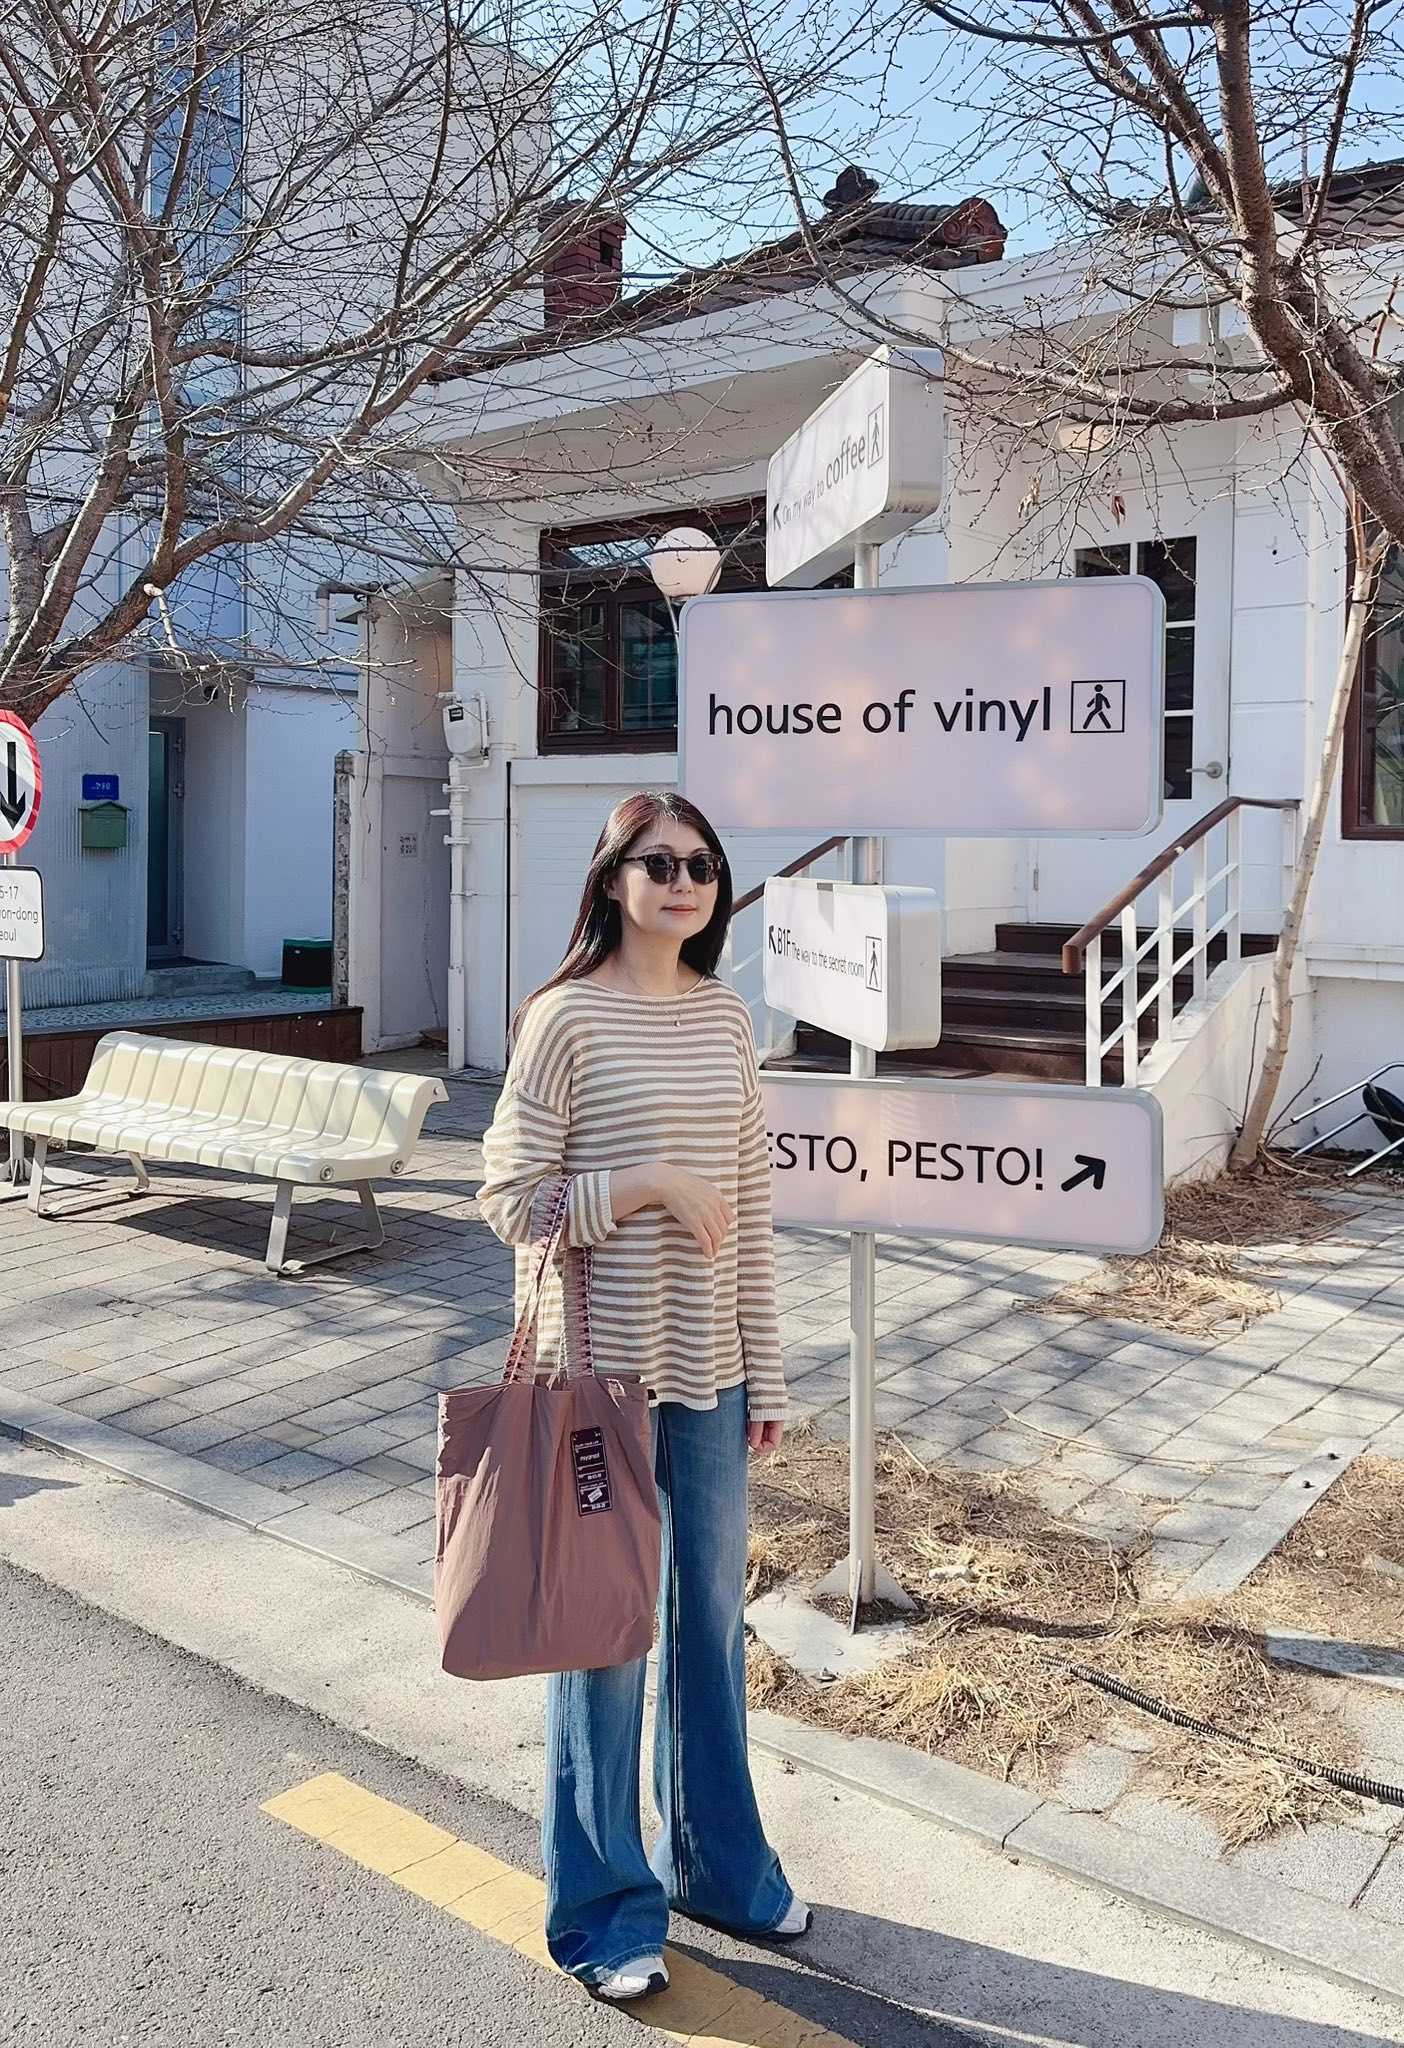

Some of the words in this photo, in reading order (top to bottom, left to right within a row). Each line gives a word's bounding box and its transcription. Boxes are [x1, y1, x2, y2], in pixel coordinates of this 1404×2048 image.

[782, 504, 792, 525] On
[803, 487, 816, 510] way
[816, 480, 825, 499] to
[826, 434, 866, 490] coffee
[709, 693, 842, 736] house
[862, 688, 916, 734] of
[933, 686, 1051, 743] vinyl
[0, 906, 39, 924] on-dong
[777, 927, 791, 957] B1F
[791, 941, 800, 961] The
[811, 949, 818, 966] to
[818, 949, 828, 969] the
[828, 955, 847, 974] secret
[847, 961, 865, 979] room
[888, 1139, 1043, 1191] PESTO!
